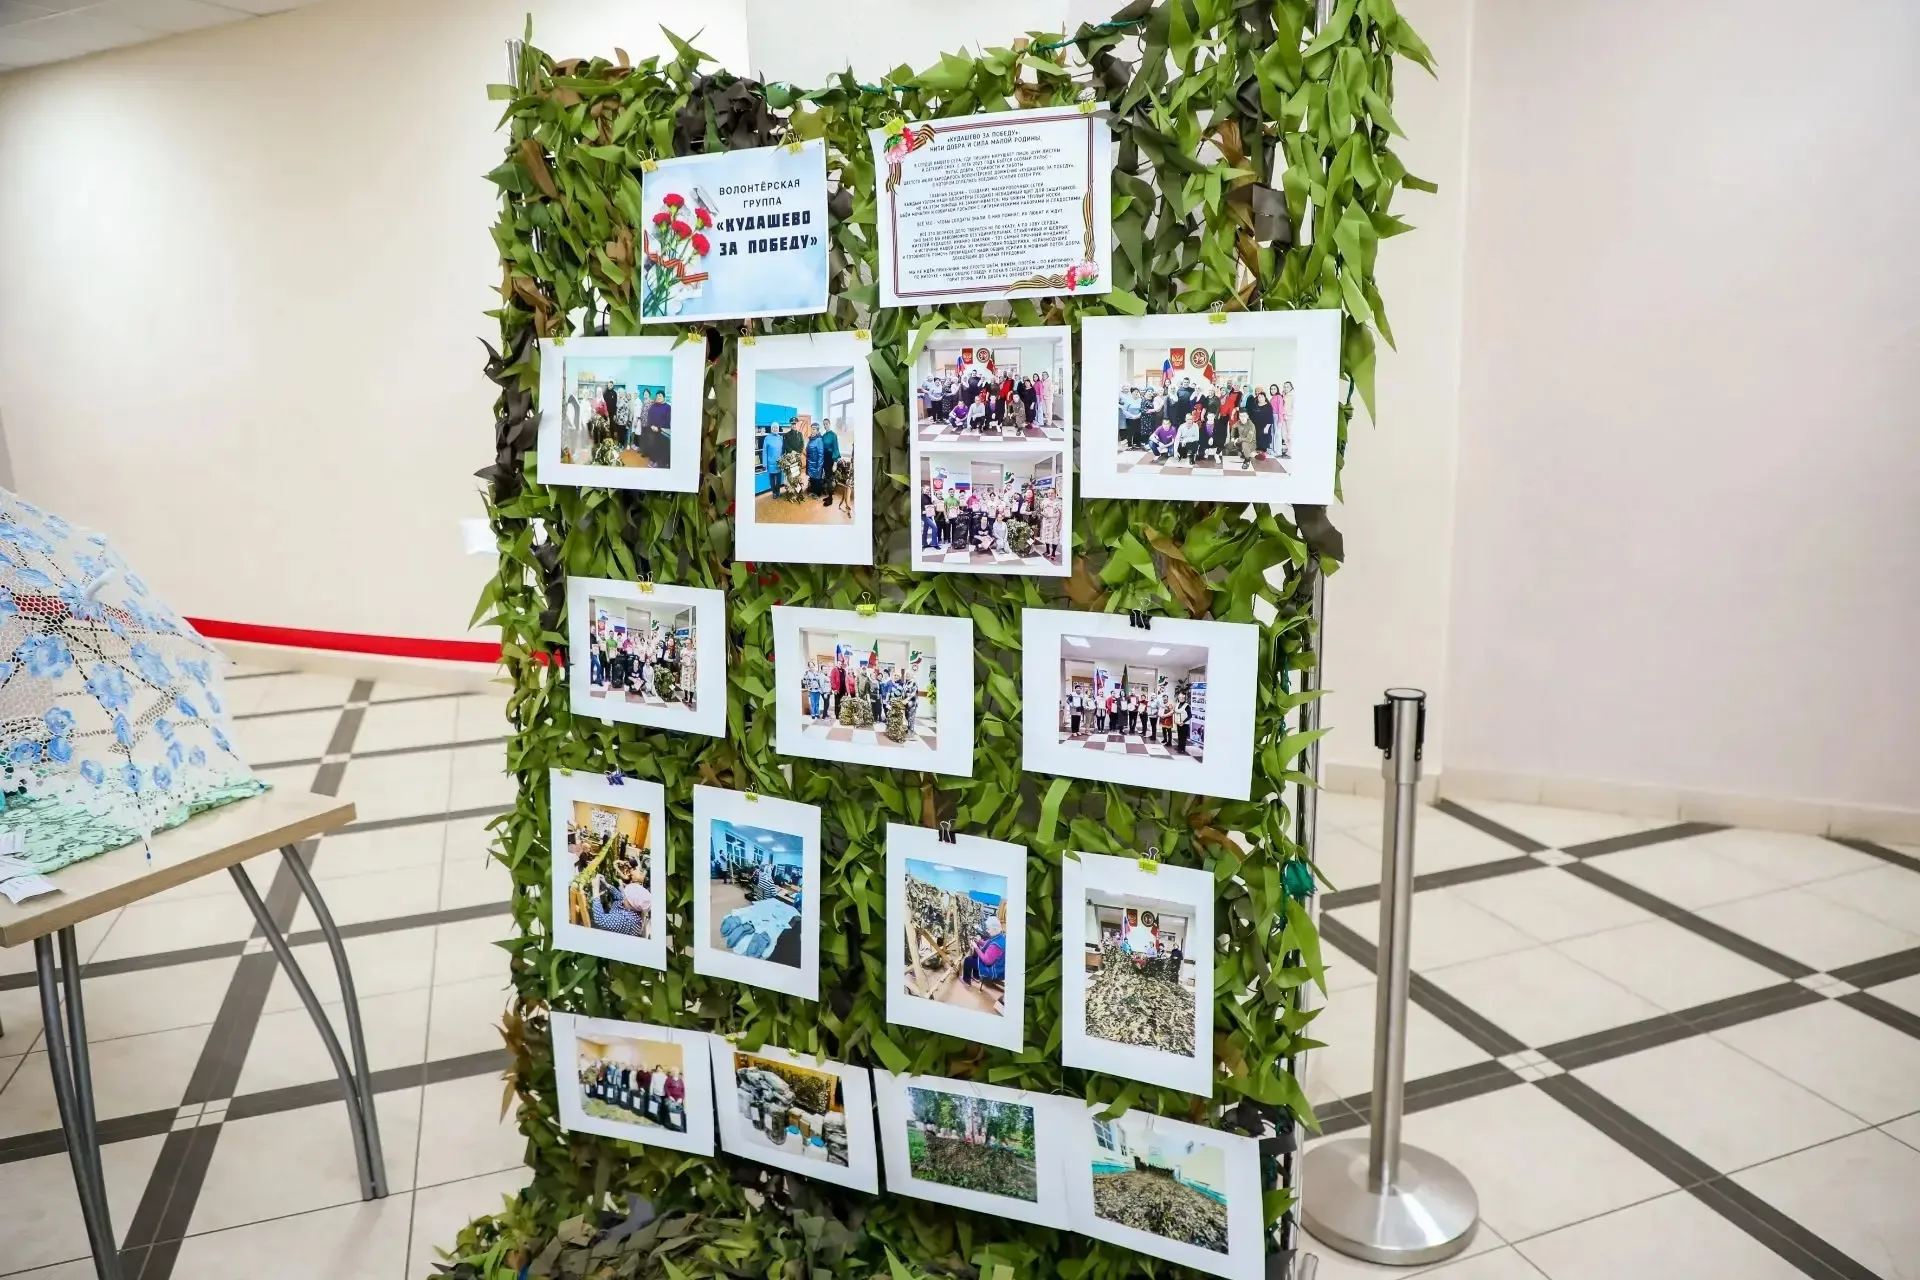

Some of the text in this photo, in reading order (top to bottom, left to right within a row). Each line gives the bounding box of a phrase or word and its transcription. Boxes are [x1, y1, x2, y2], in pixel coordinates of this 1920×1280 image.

[930, 145, 945, 153] НИТИ
[946, 143, 965, 151] ДОБРА
[974, 140, 989, 148] СИЛА
[990, 137, 1012, 146] МАЛОЙ
[947, 134, 981, 143] «КУДАШЕВО
[719, 179, 800, 196] ВОЛОНТЁРСКАЯ
[743, 197, 782, 209] ГРУППА
[716, 210, 811, 232] «КУДАШЕВО
[719, 234, 818, 257] ЗА ПОБЕДУ»
